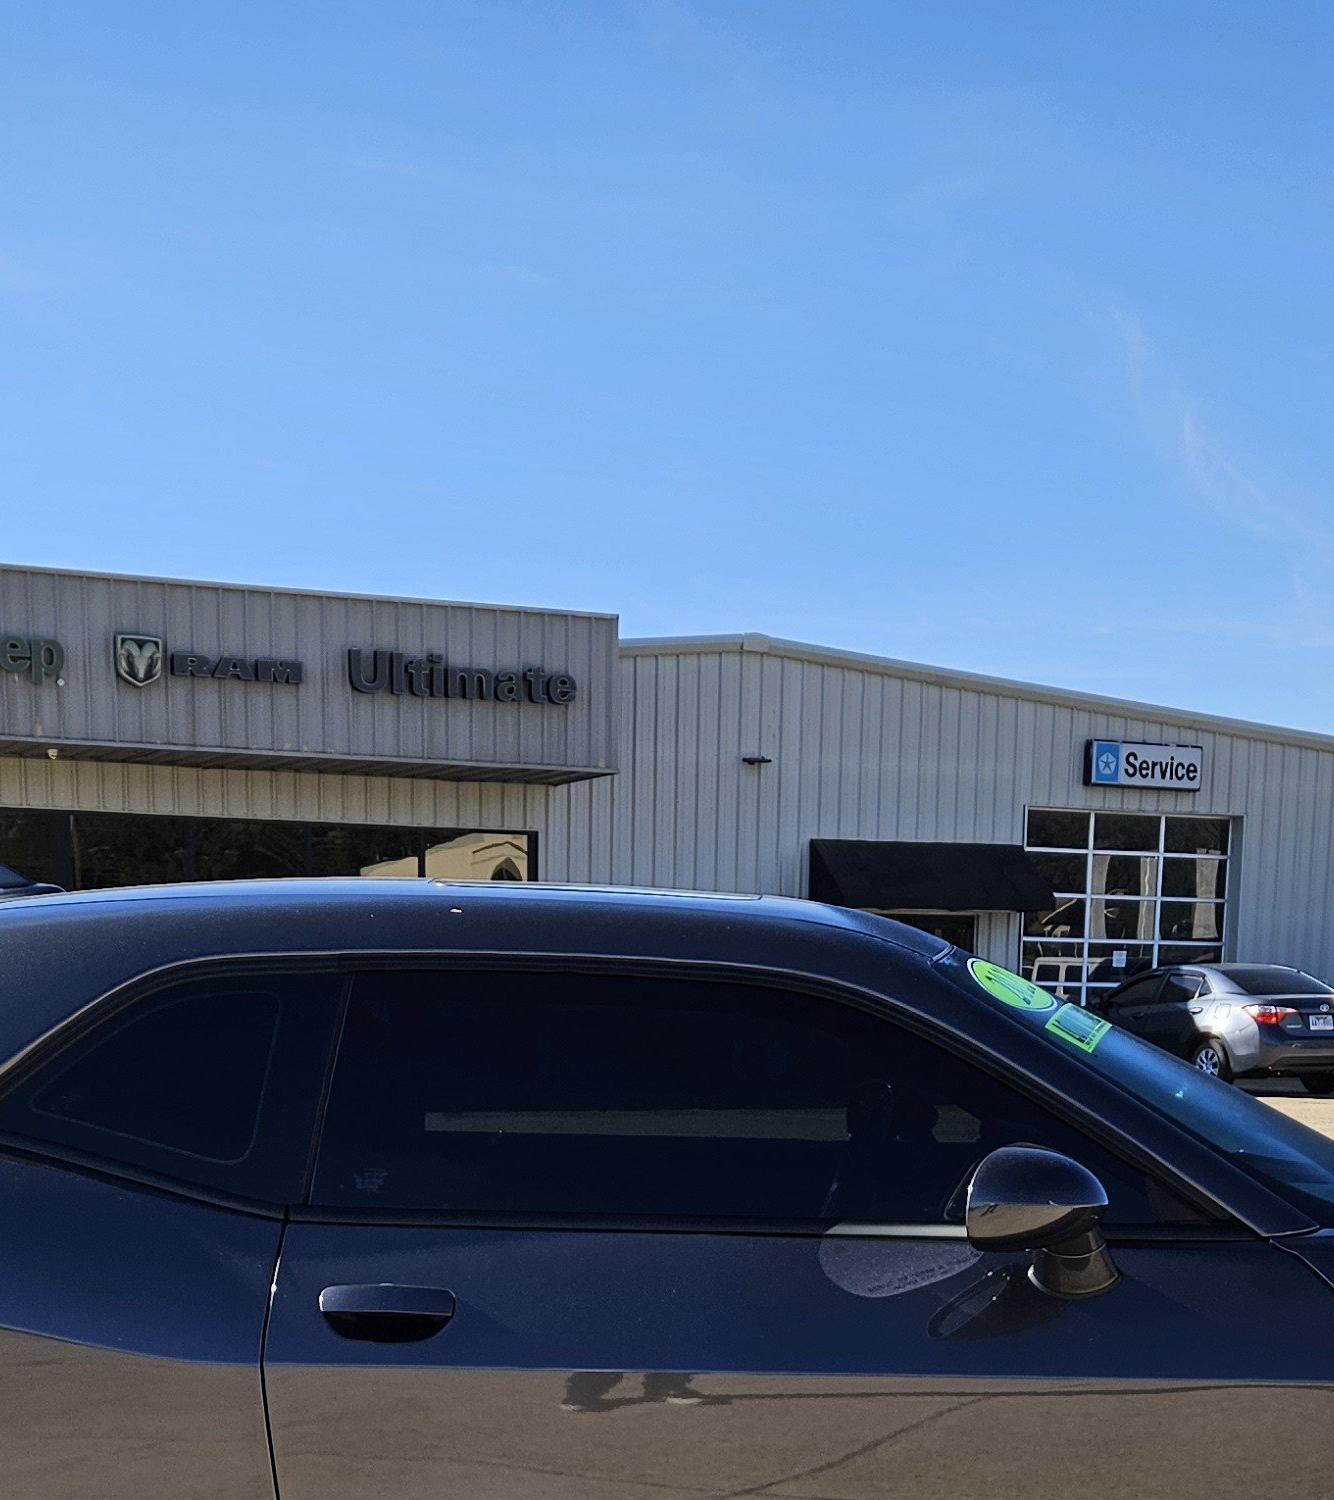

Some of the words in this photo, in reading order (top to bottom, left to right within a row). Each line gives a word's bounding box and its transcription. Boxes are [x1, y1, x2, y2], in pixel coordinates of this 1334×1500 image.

[170, 651, 305, 684] RAM
[348, 647, 578, 705] Ultimate
[1124, 751, 1198, 781] Service
